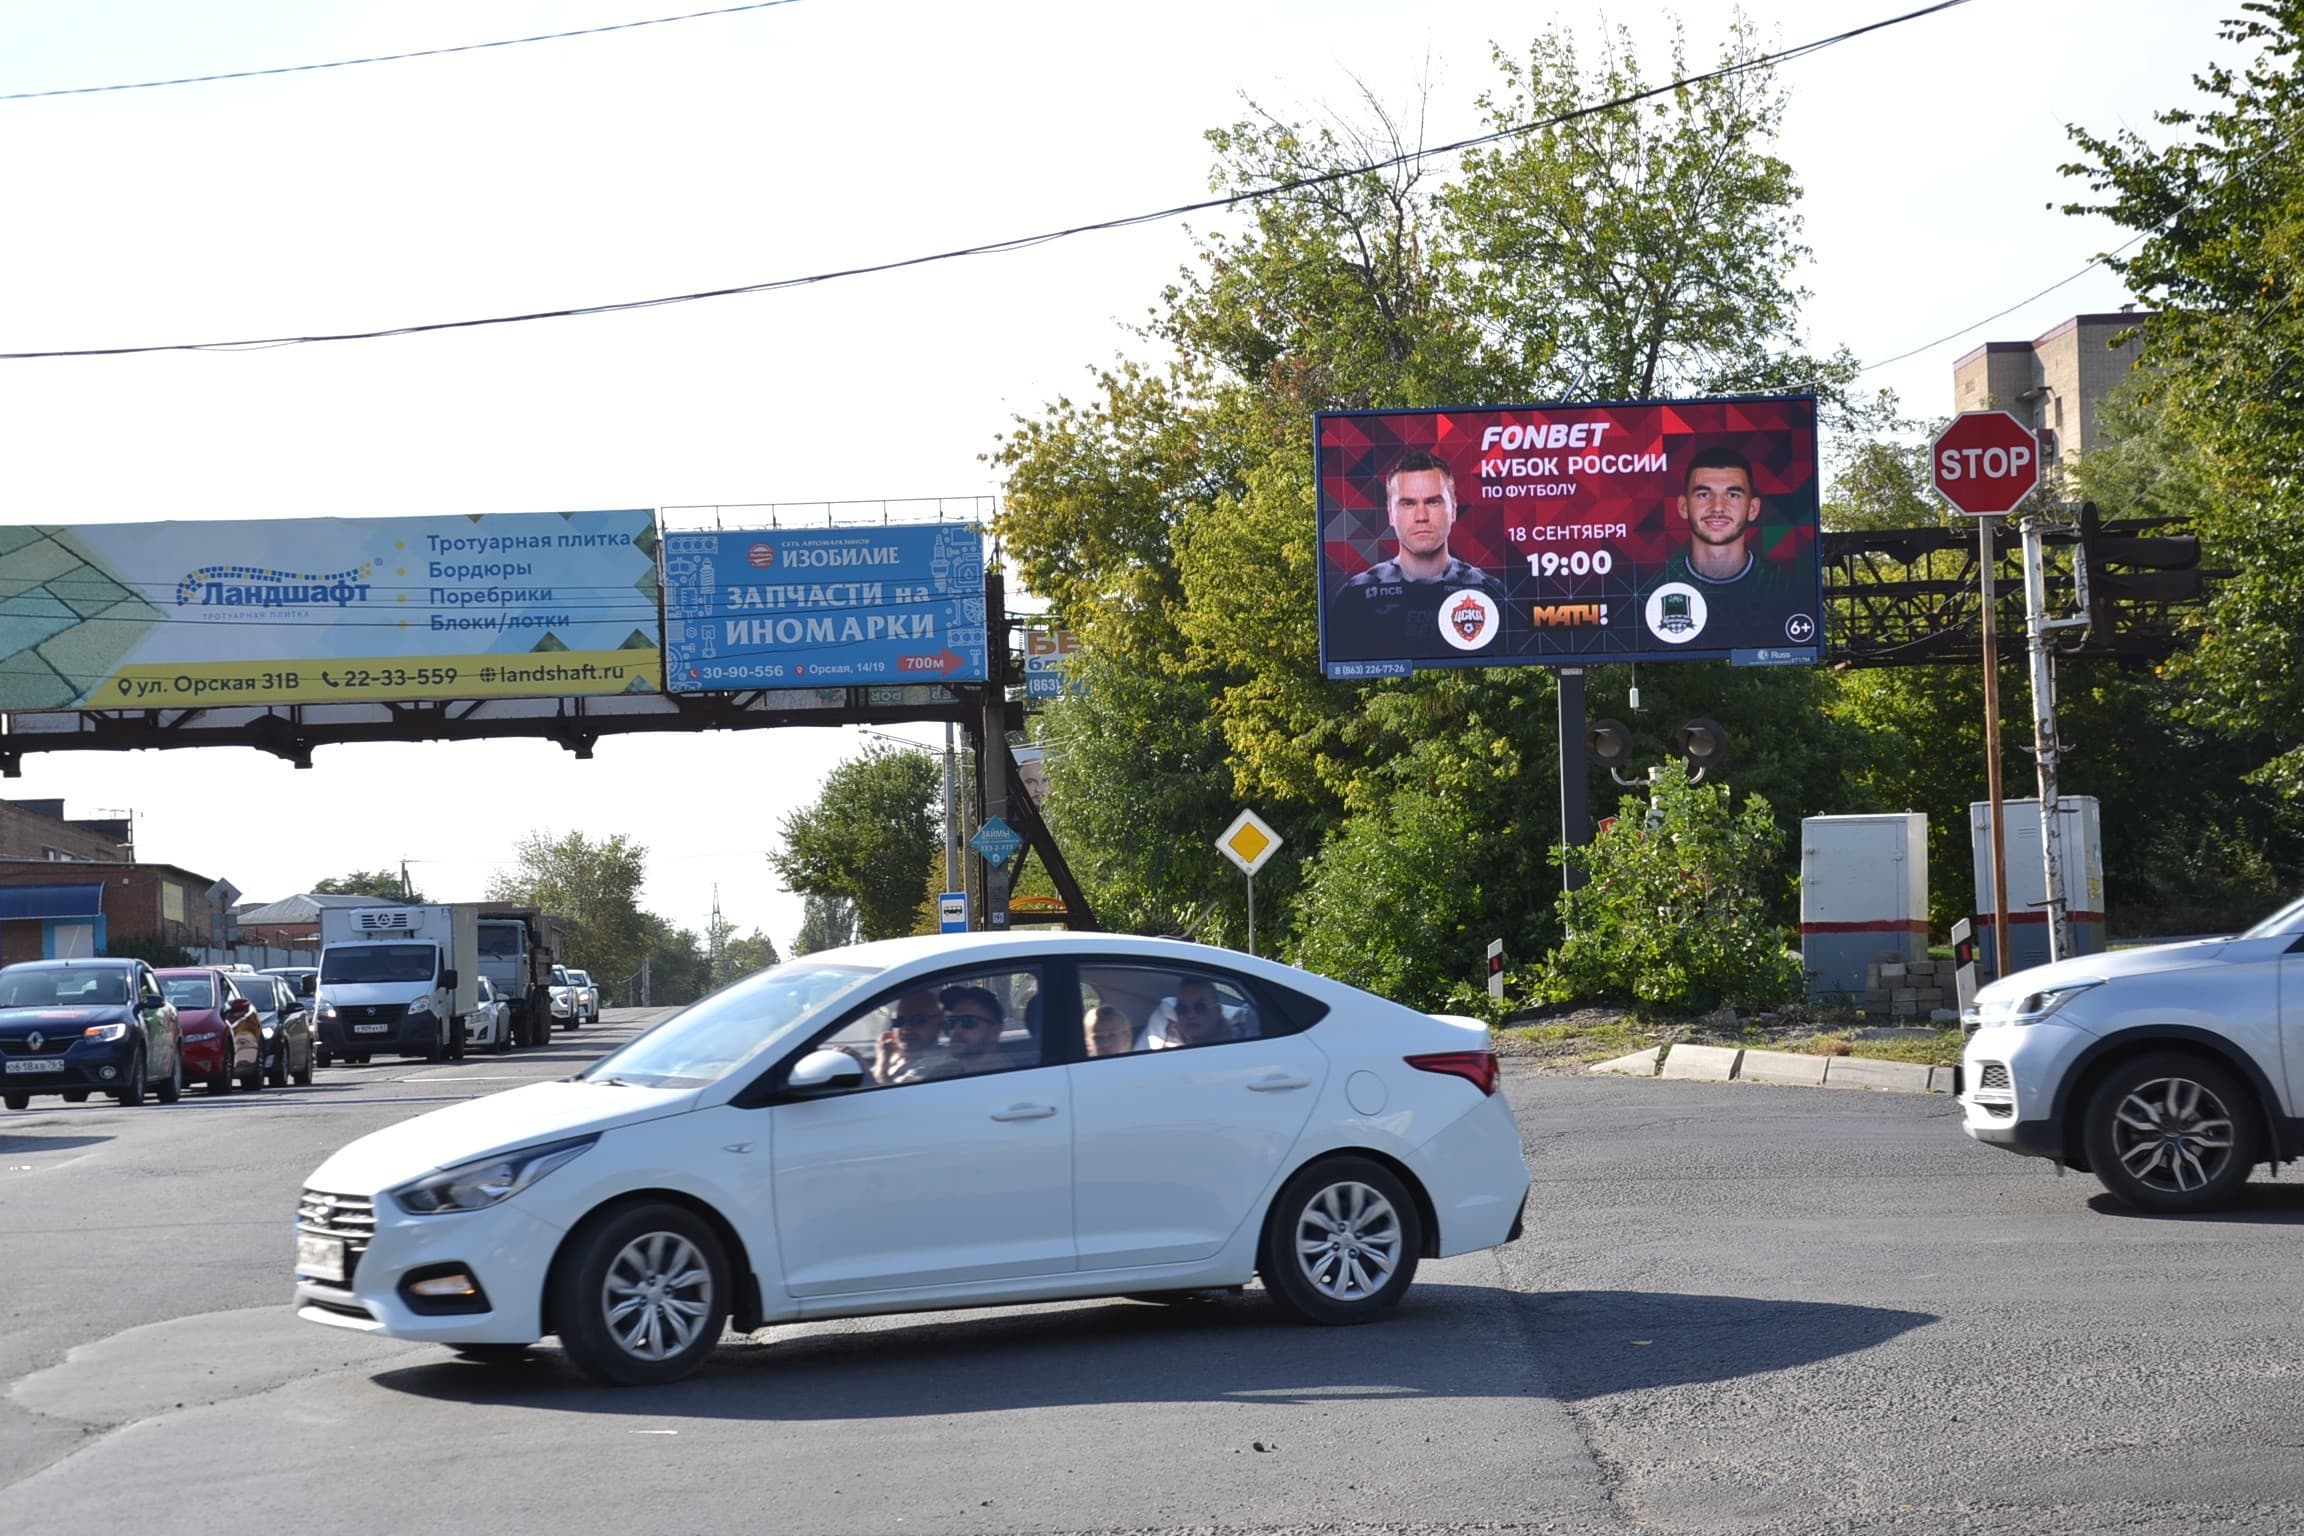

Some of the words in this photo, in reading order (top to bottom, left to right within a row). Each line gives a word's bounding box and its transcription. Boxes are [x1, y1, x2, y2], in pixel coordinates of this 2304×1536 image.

[1481, 422, 1610, 451] FONBET
[1481, 457, 1559, 478] КУБОК
[1568, 453, 1667, 475] РОССИИ
[1940, 446, 2031, 480] STOP
[1482, 486, 1502, 498] ПО
[1505, 483, 1577, 497] ФУТБОЛУ
[1508, 527, 1527, 541] 18
[1532, 523, 1627, 540] СЕНТЯБРЯ
[427, 535, 552, 555] Тротуарная
[557, 533, 631, 547] плитка
[783, 547, 900, 568] ИЗОБИЛИЕ
[1526, 550, 1612, 576] 19:00
[429, 561, 532, 582] Бордюры
[202, 580, 370, 607] Ландшафт
[430, 587, 552, 608] Поребрики
[727, 583, 882, 610] ЗАПЧАСТИ
[895, 586, 931, 604] на
[431, 613, 570, 633] Блоки/лотки
[1453, 609, 1484, 623] ЦСКА
[1533, 603, 1609, 627] МАТЧ!
[726, 614, 935, 645] ИНОМАРКИ
[1790, 620, 1811, 635] 6+
[500, 664, 624, 683] landshaft.ru
[703, 665, 784, 679] 30-90-556
[809, 664, 853, 675] Орская,
[856, 662, 885, 673] 14/19
[906, 657, 944, 670] 700м
[1342, 665, 1363, 676] (863)
[1365, 659, 1405, 674] 226-77-26
[137, 681, 168, 698] ул.
[174, 676, 256, 696] Орская
[261, 673, 299, 690] 31В
[344, 668, 458, 687] 22-33-559
[1029, 679, 1060, 694] (863)
